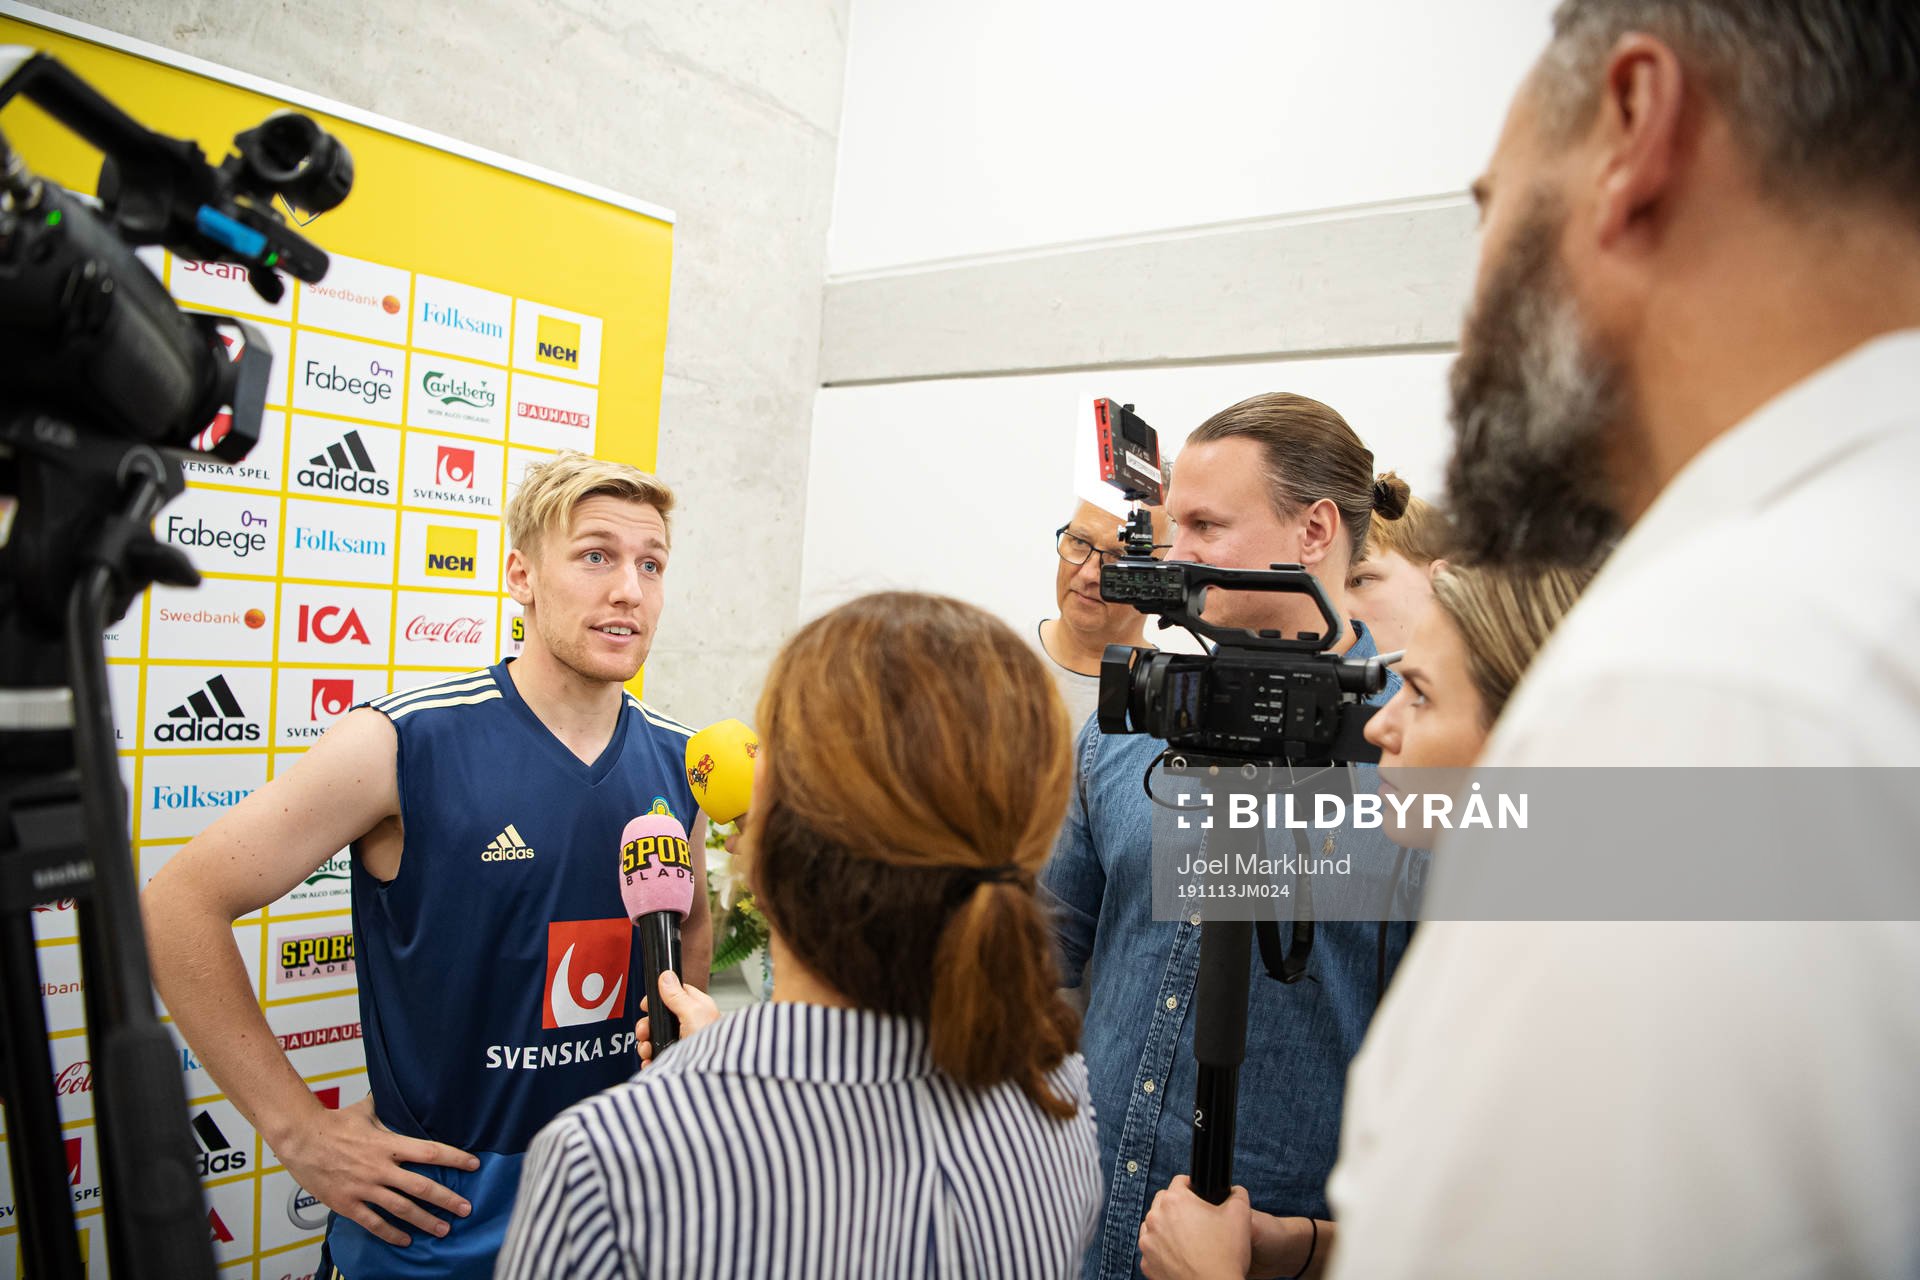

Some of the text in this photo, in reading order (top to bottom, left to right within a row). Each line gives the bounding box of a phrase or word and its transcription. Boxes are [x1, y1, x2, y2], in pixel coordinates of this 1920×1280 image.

[309, 282, 378, 307] Swedbank
[423, 302, 503, 339] Folksam
[305, 360, 392, 405] Fabege
[422, 370, 496, 408] Carlsberg
[517, 402, 590, 429] BAUHAUS
[181, 461, 271, 481] VENSKA SPEL
[297, 467, 390, 496] adidas
[413, 488, 493, 507] SVENSKA SPEL
[167, 515, 266, 558] Fabege
[294, 527, 386, 556] Folksam
[159, 608, 241, 625] Swedbank
[297, 604, 371, 645] ICA
[153, 717, 261, 743] adidas
[286, 727, 326, 738] SVENS
[480, 847, 536, 863] adidas
[623, 835, 694, 877] SPOR
[625, 867, 694, 887] BLADE
[329, 888, 350, 897] ORGA
[285, 962, 348, 979] BLADE
[485, 1037, 604, 1071] SVENSKA
[74, 1186, 101, 1202] SPE
